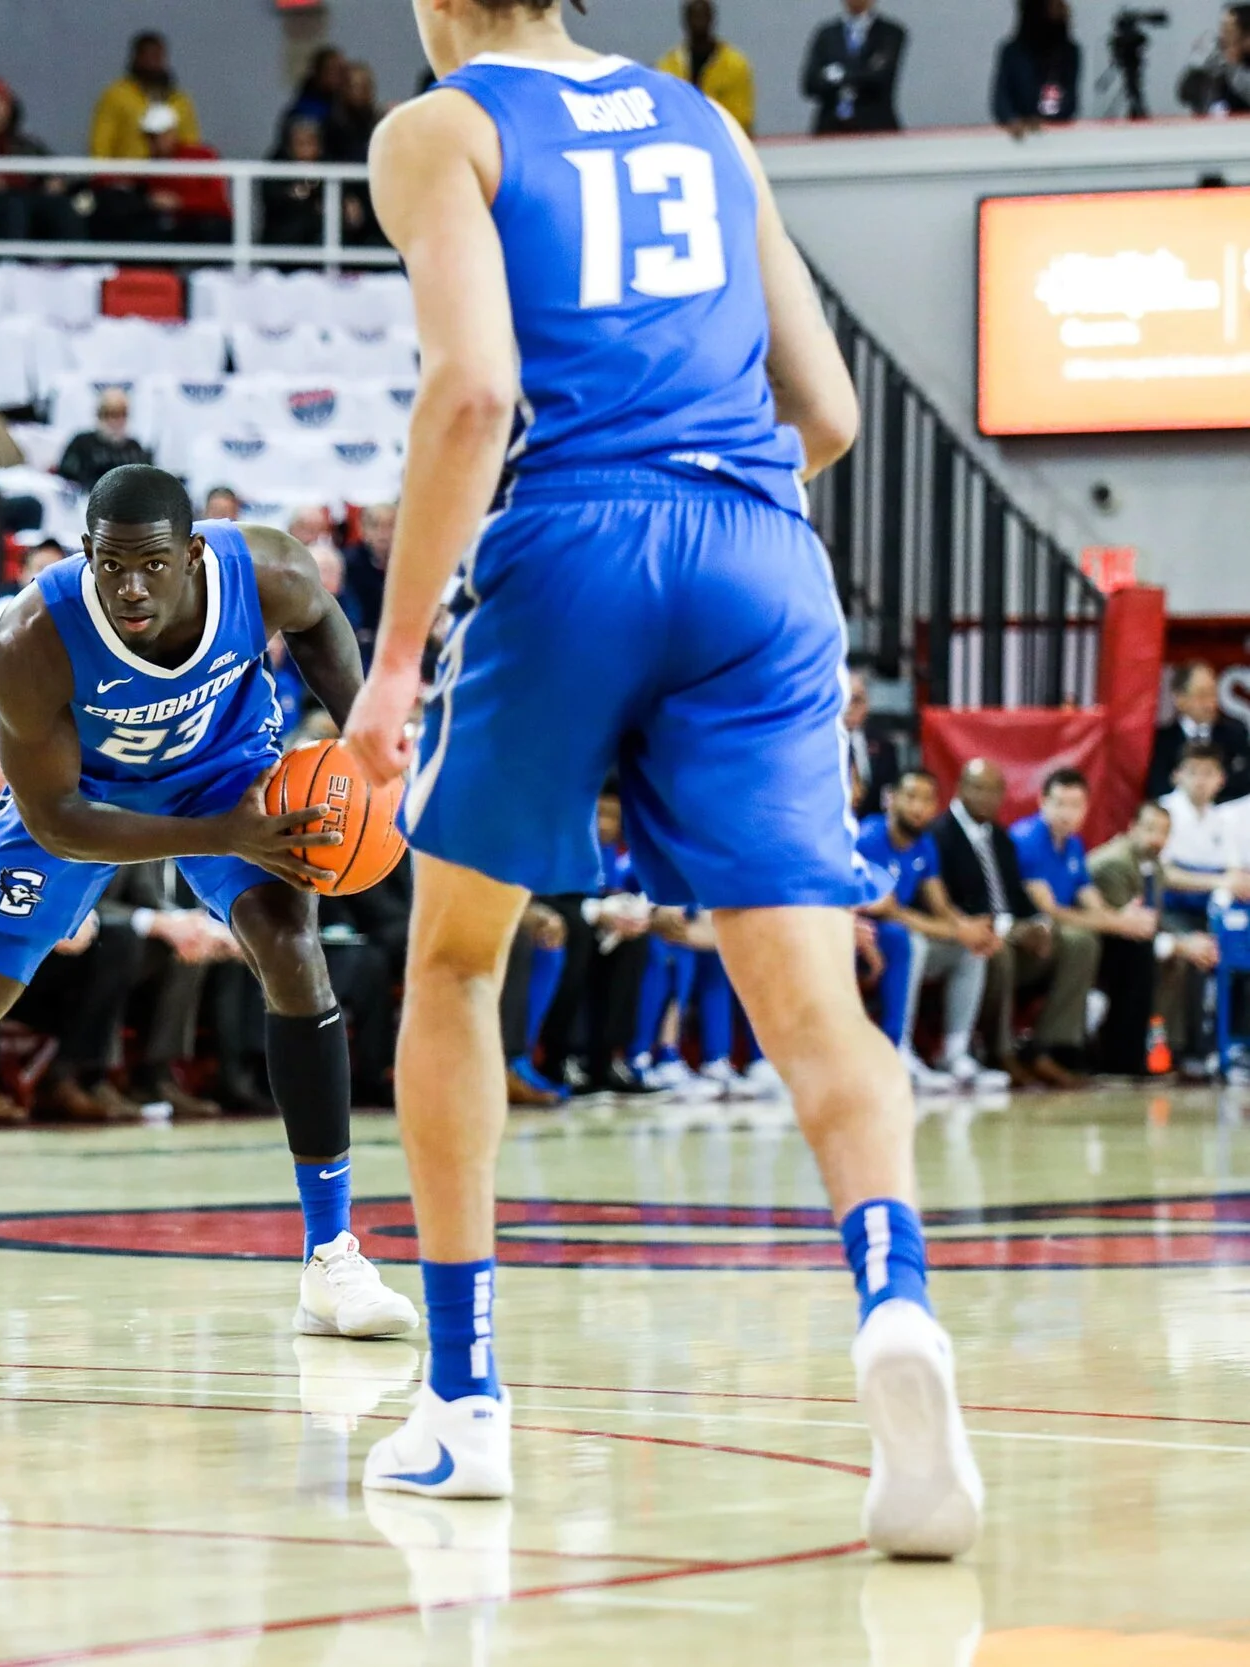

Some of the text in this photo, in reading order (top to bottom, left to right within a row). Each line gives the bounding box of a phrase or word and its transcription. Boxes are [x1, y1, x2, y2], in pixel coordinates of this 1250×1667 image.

[561, 142, 726, 309] 13
[83, 659, 250, 725] CREIGHTON
[96, 699, 217, 764] 23
